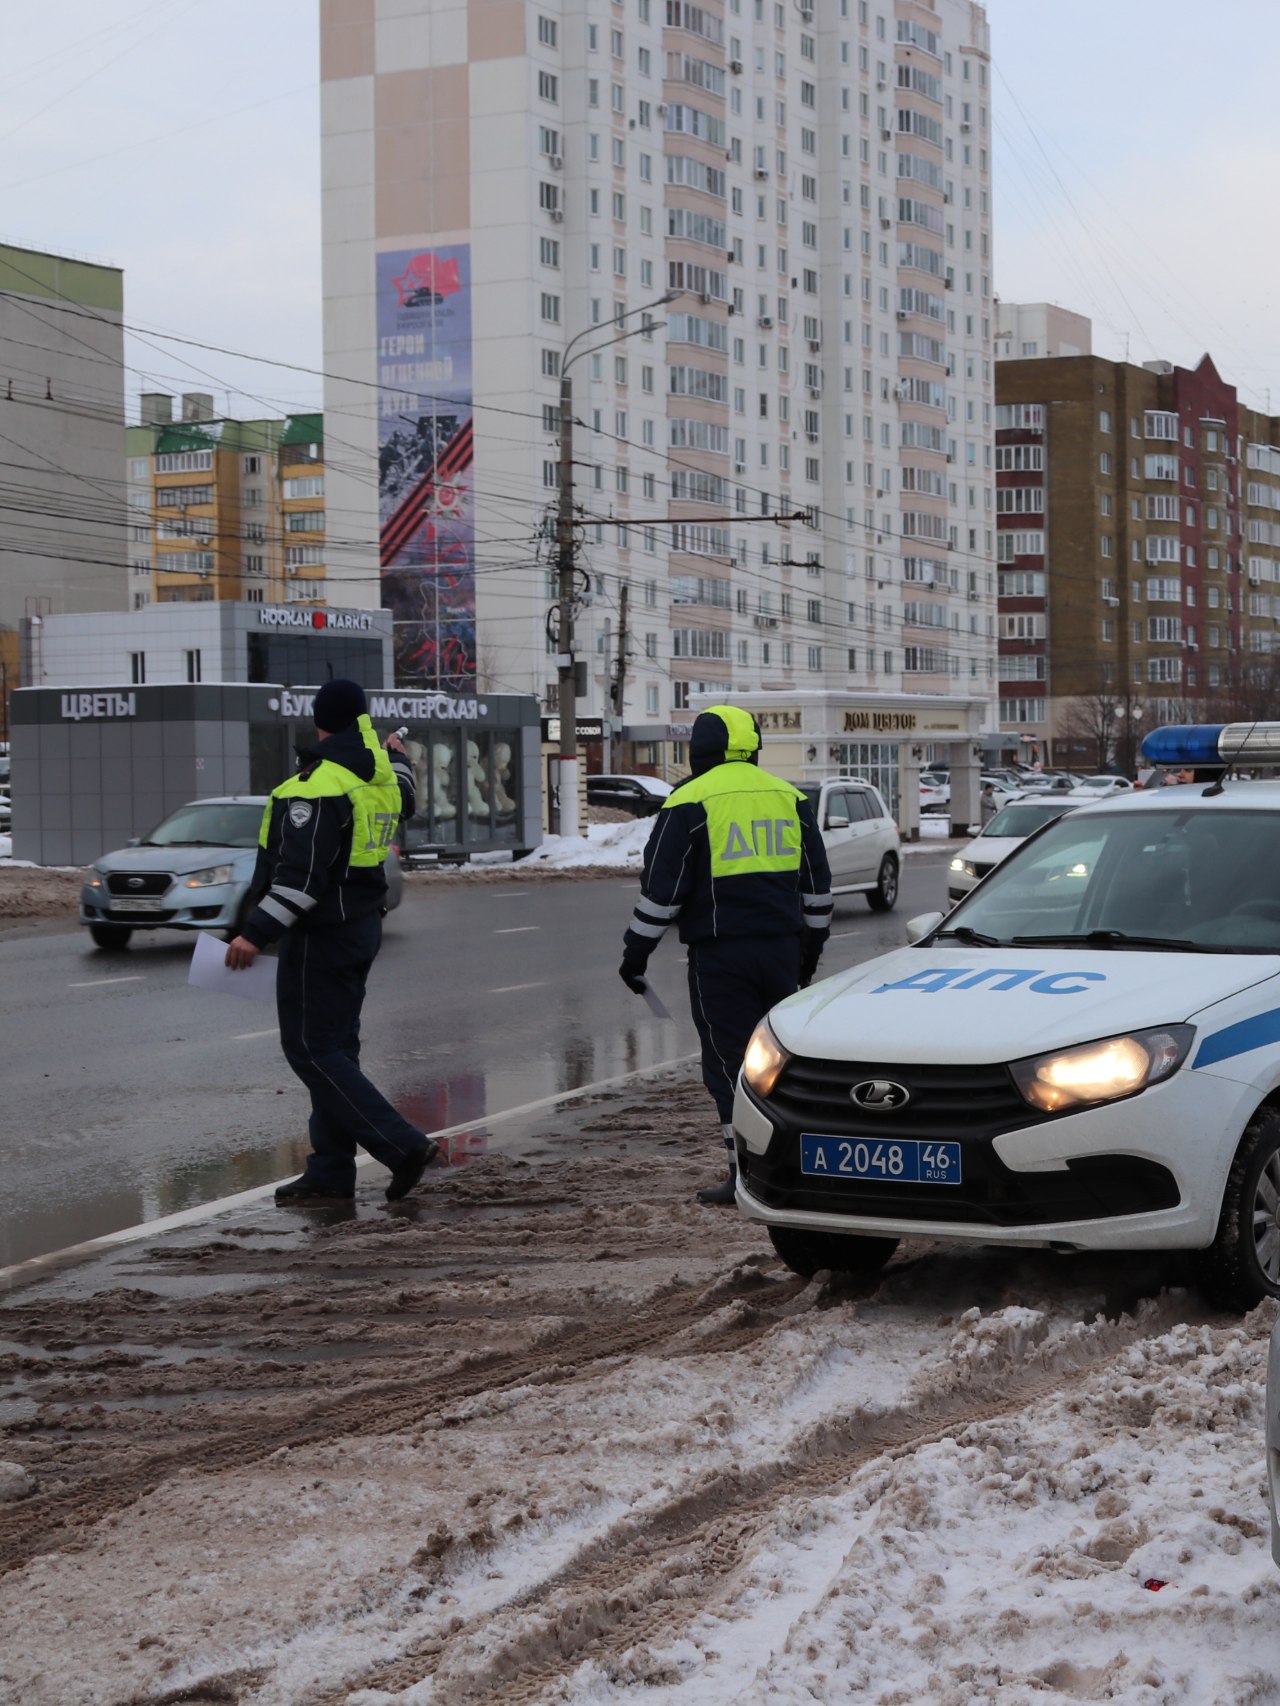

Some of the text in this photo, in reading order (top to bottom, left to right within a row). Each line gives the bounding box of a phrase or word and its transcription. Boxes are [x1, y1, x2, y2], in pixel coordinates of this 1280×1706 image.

[380, 334, 424, 357] ГЕРОИ
[260, 608, 373, 630] HOOKAH MARKET
[61, 692, 136, 720] ЦВЕТЫ
[370, 694, 478, 719] МАСТЕРСКАЯ
[757, 712, 802, 728] ЕТЫ
[844, 712, 870, 732] ДОМ
[721, 819, 796, 860] ДПС
[869, 968, 1107, 994] ДПС
[838, 1142, 904, 1175] 2048
[922, 1145, 950, 1169] 46
[926, 1170, 947, 1179] RUS
